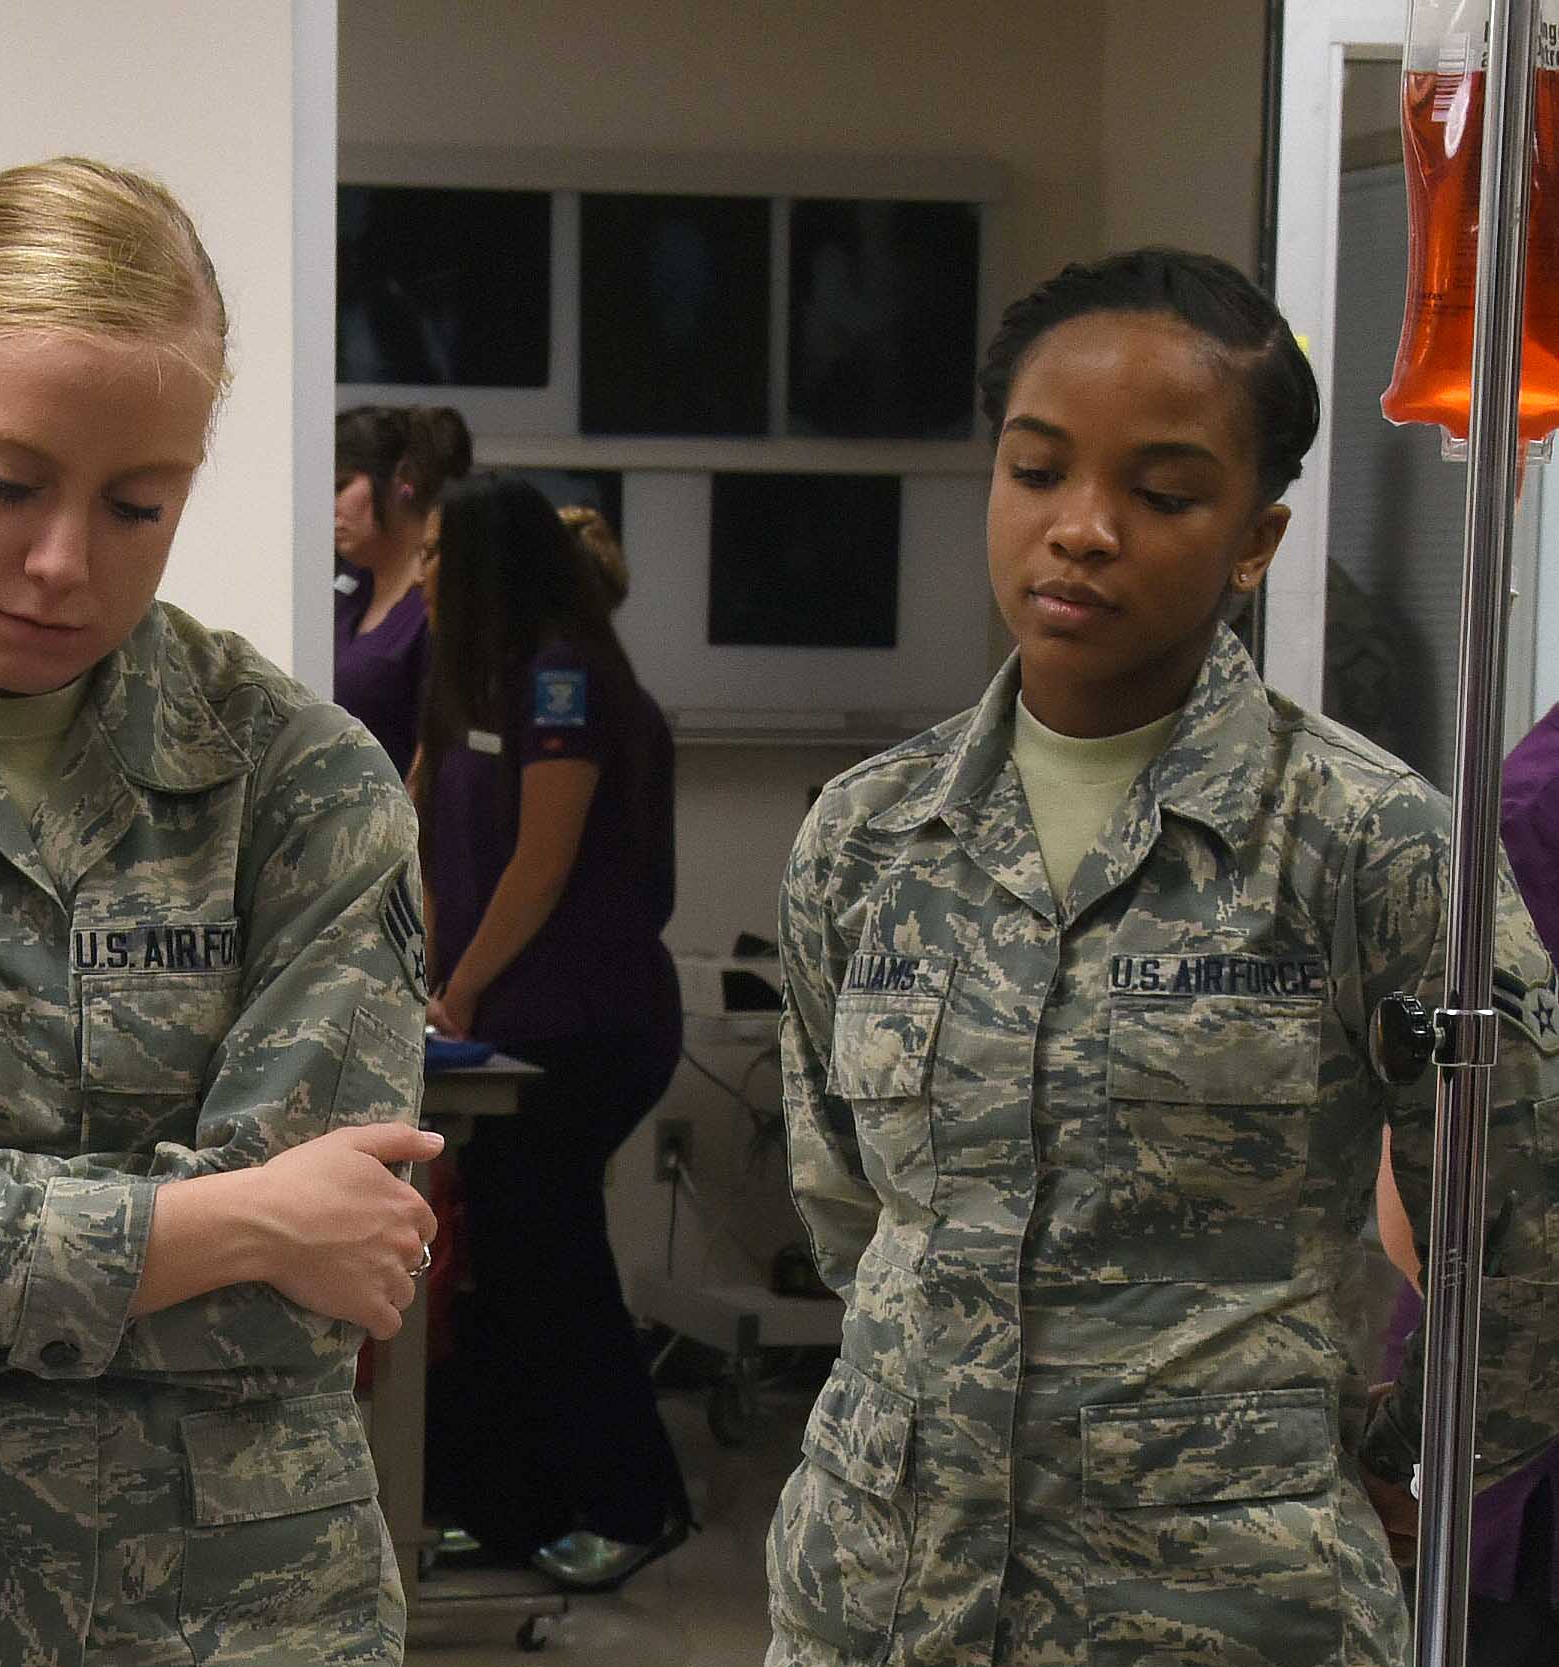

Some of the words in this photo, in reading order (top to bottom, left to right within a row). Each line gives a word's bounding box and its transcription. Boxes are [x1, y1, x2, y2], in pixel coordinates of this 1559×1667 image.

[75, 931, 136, 968] U.S.
[144, 928, 198, 968] AIR
[847, 954, 916, 990] LLIAMS
[1112, 955, 1166, 991] U.S.
[1172, 957, 1224, 994] AIR
[1228, 957, 1324, 996] FORCE
